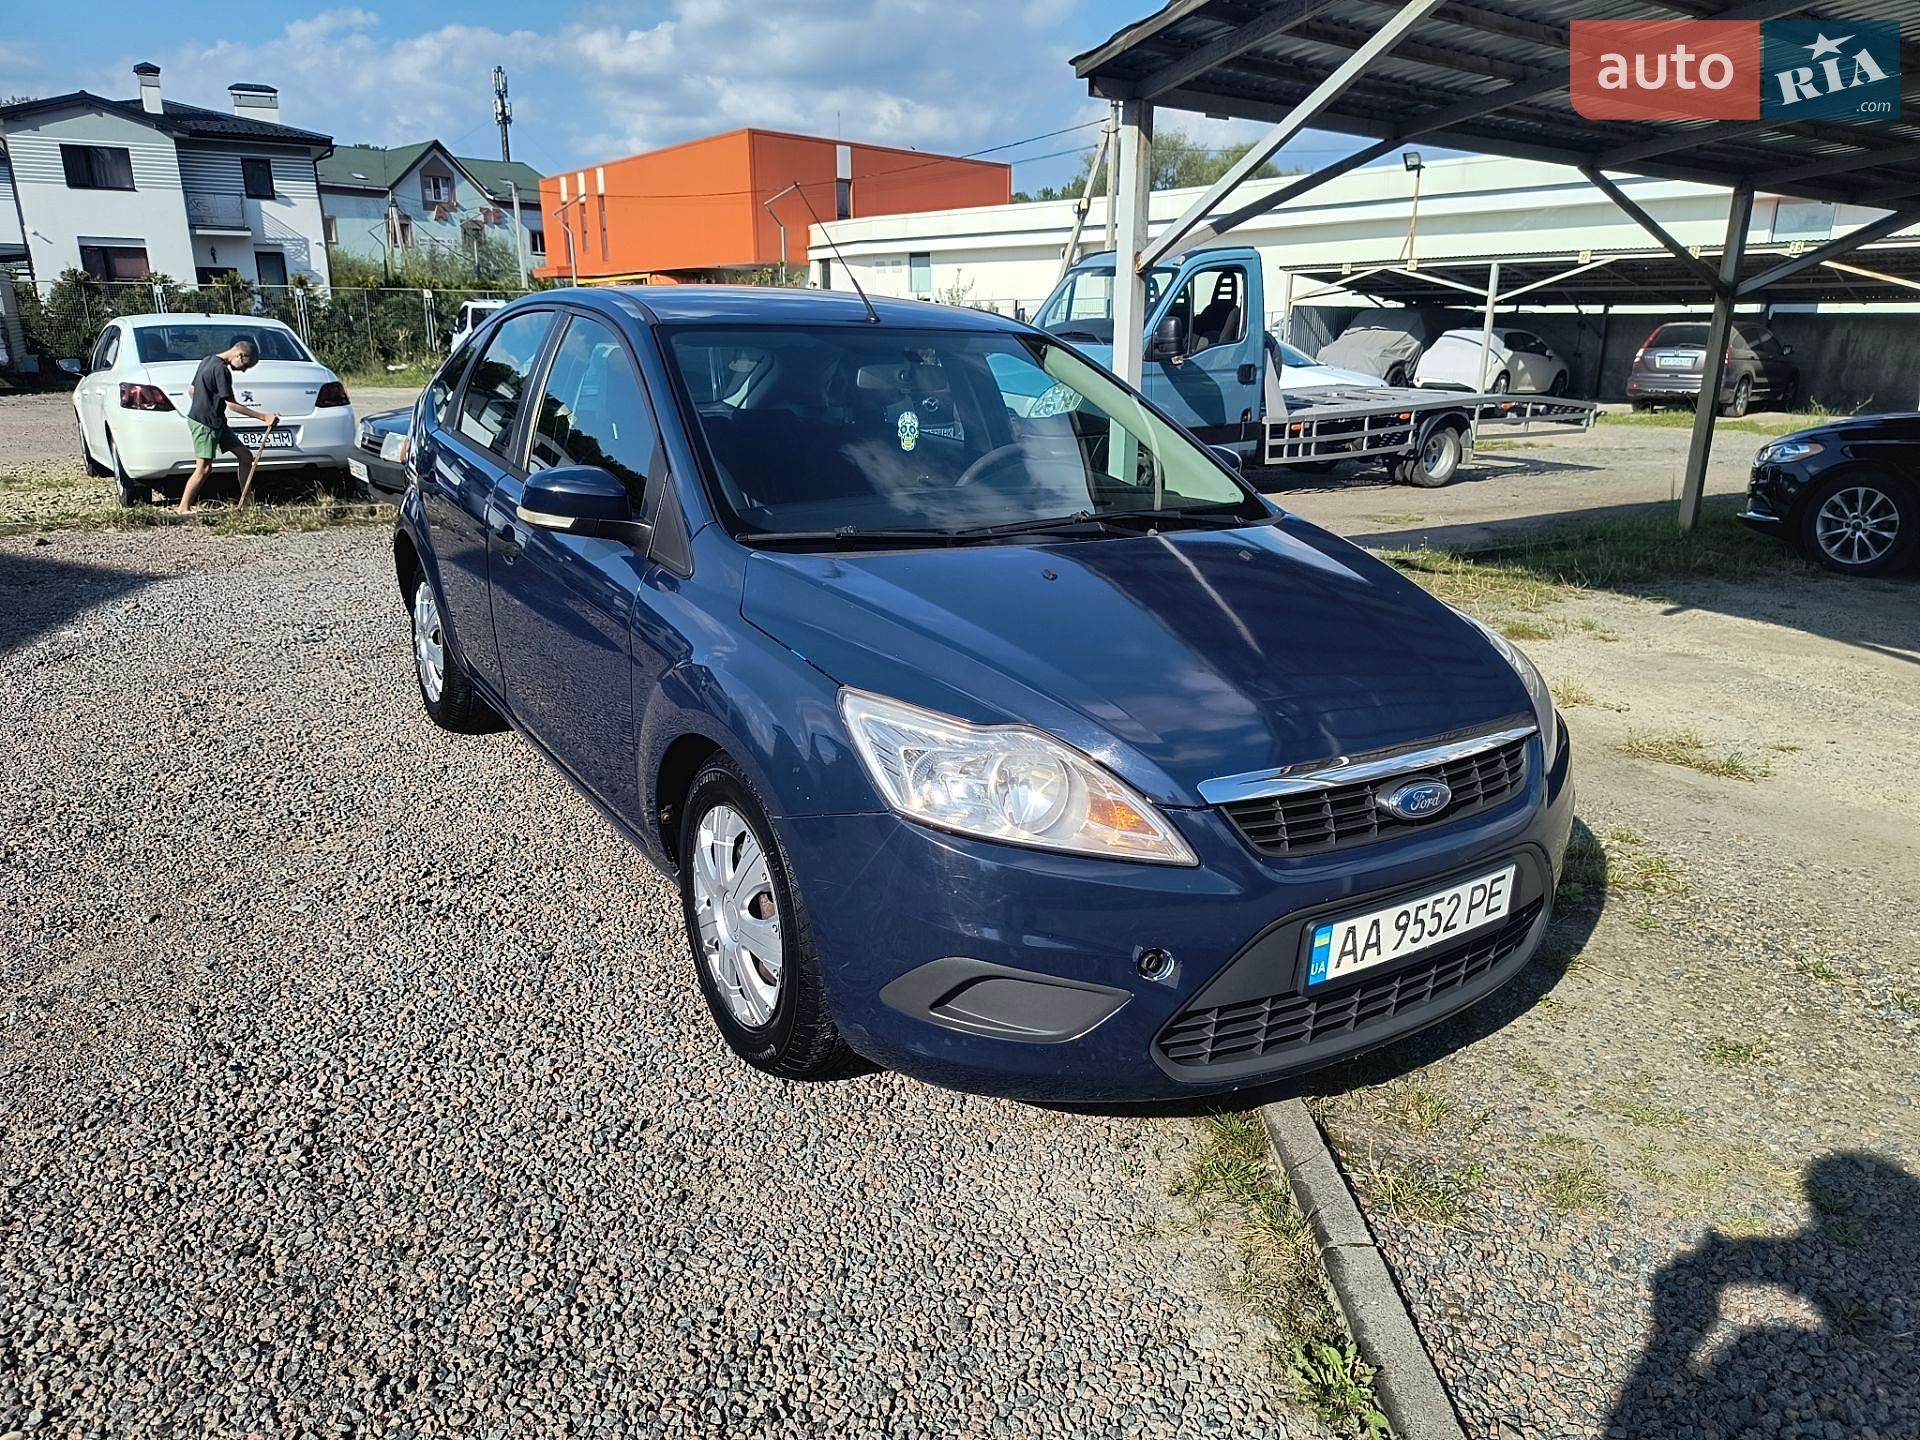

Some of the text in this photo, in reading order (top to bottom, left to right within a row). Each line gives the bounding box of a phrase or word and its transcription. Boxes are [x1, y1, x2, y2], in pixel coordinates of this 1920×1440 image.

[273, 433, 291, 443] HM
[1410, 789, 1441, 811] Ford
[1334, 874, 1506, 969] AA 9552 PE
[1310, 961, 1326, 976] UA
